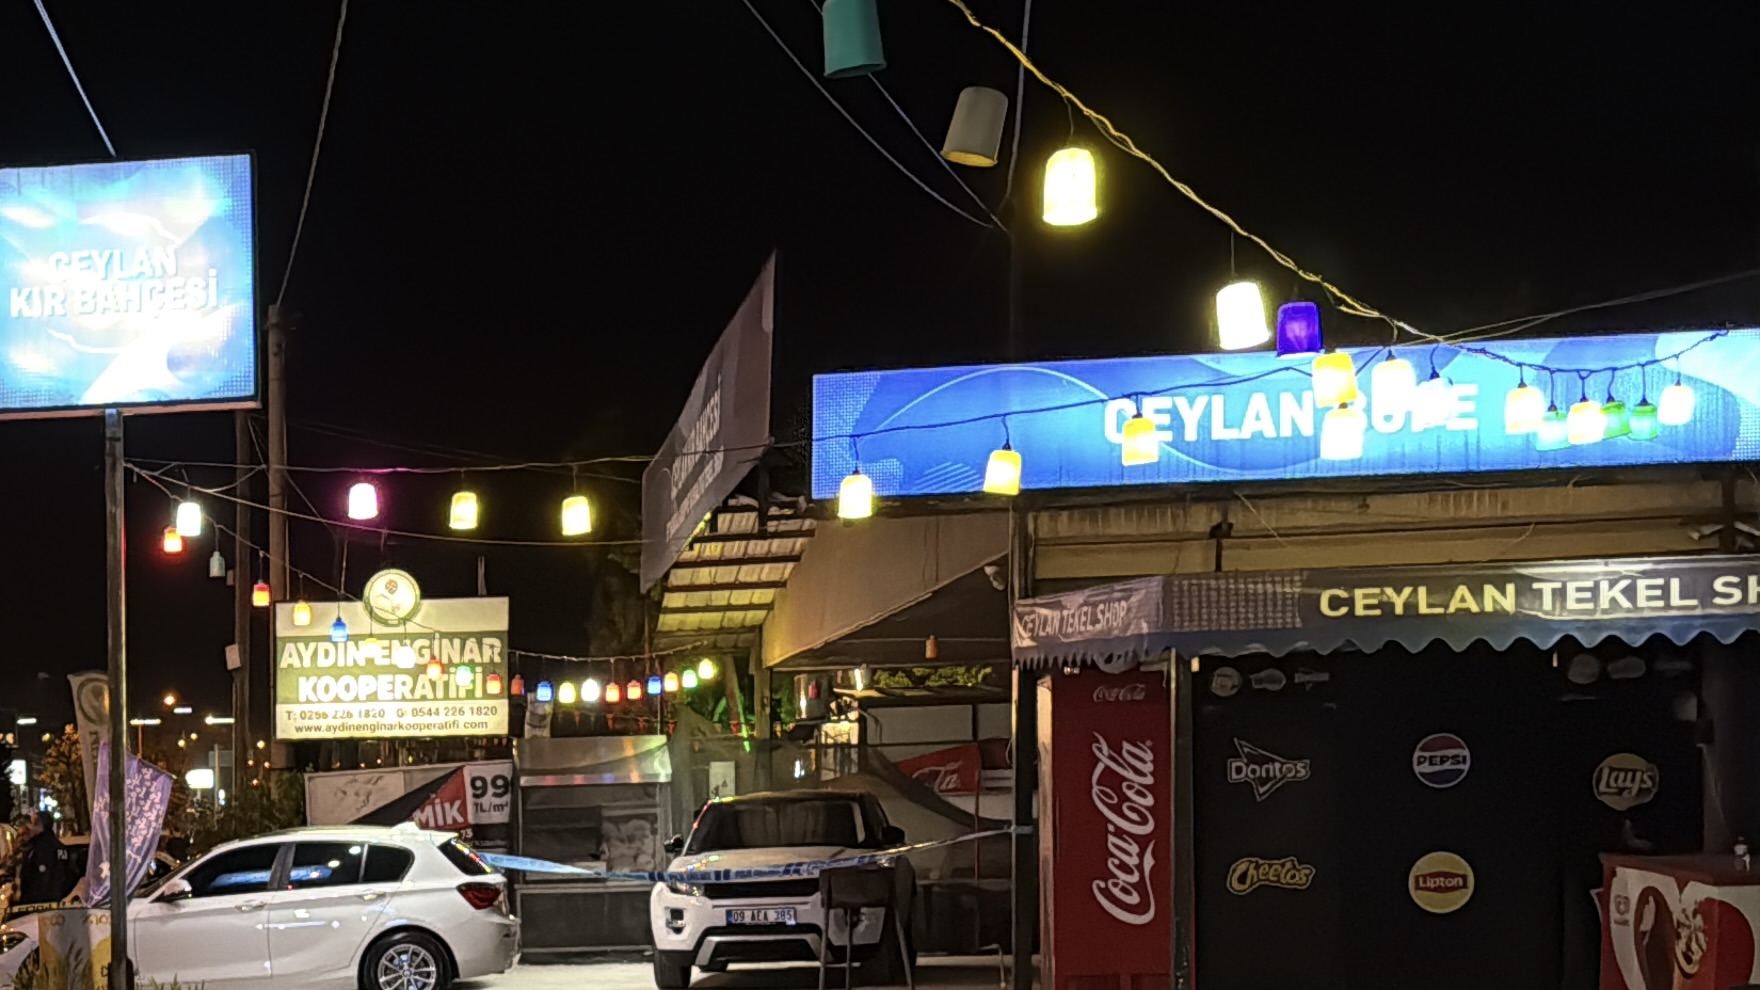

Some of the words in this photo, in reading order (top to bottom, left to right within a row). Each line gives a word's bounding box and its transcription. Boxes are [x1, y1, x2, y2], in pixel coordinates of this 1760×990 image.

[47, 248, 178, 281] CEYLAN
[9, 286, 67, 318] KIR
[1103, 390, 1315, 444] CEYLAN
[1319, 583, 1517, 617] CEYLAN
[1531, 577, 1699, 611] TEKEL
[1096, 600, 1128, 630] SHOP
[443, 706, 466, 717] 226
[469, 705, 499, 717] 1820
[1230, 760, 1307, 781] Doritos
[1415, 754, 1468, 768] PEPSI
[470, 775, 510, 799] 99
[1230, 858, 1313, 893] Cheetos
[1418, 874, 1464, 891] Lipton
